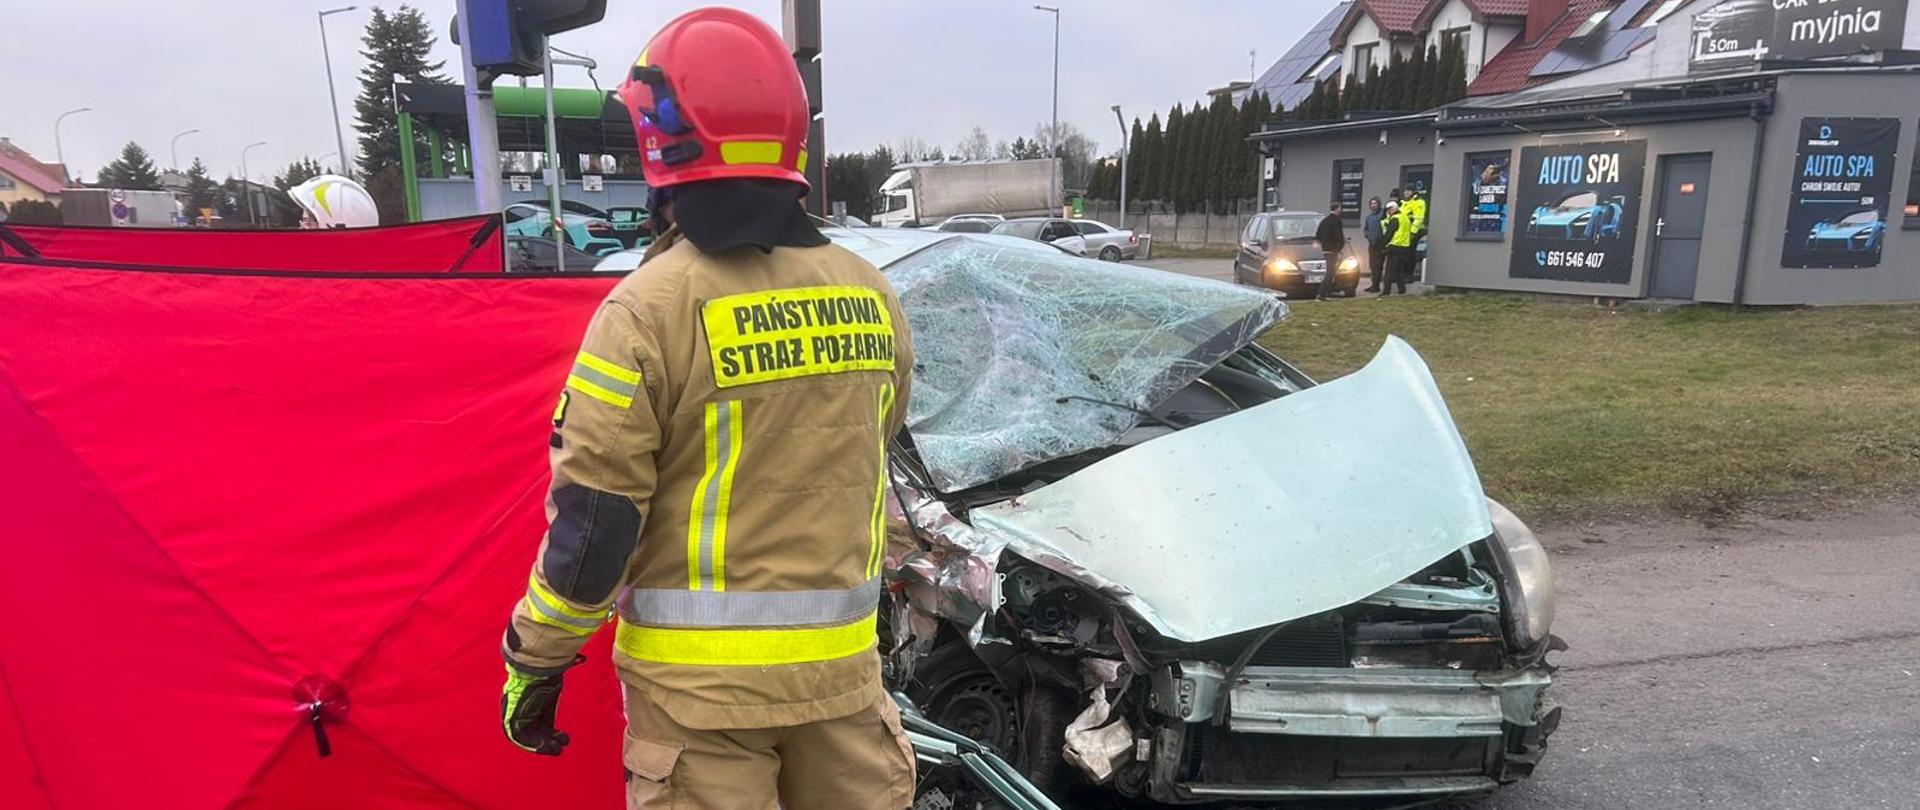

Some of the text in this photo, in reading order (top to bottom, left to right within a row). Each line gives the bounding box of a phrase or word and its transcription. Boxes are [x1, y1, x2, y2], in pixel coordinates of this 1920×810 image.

[1790, 7, 1882, 44] myjnia
[1538, 153, 1620, 185] AUTO SPA
[1803, 154, 1874, 177] AUTO SPA
[1547, 251, 1604, 268] 661 546 407
[733, 297, 883, 335] PAŃSTWOWA
[719, 333, 893, 377] STRAŻ POŻARNA
